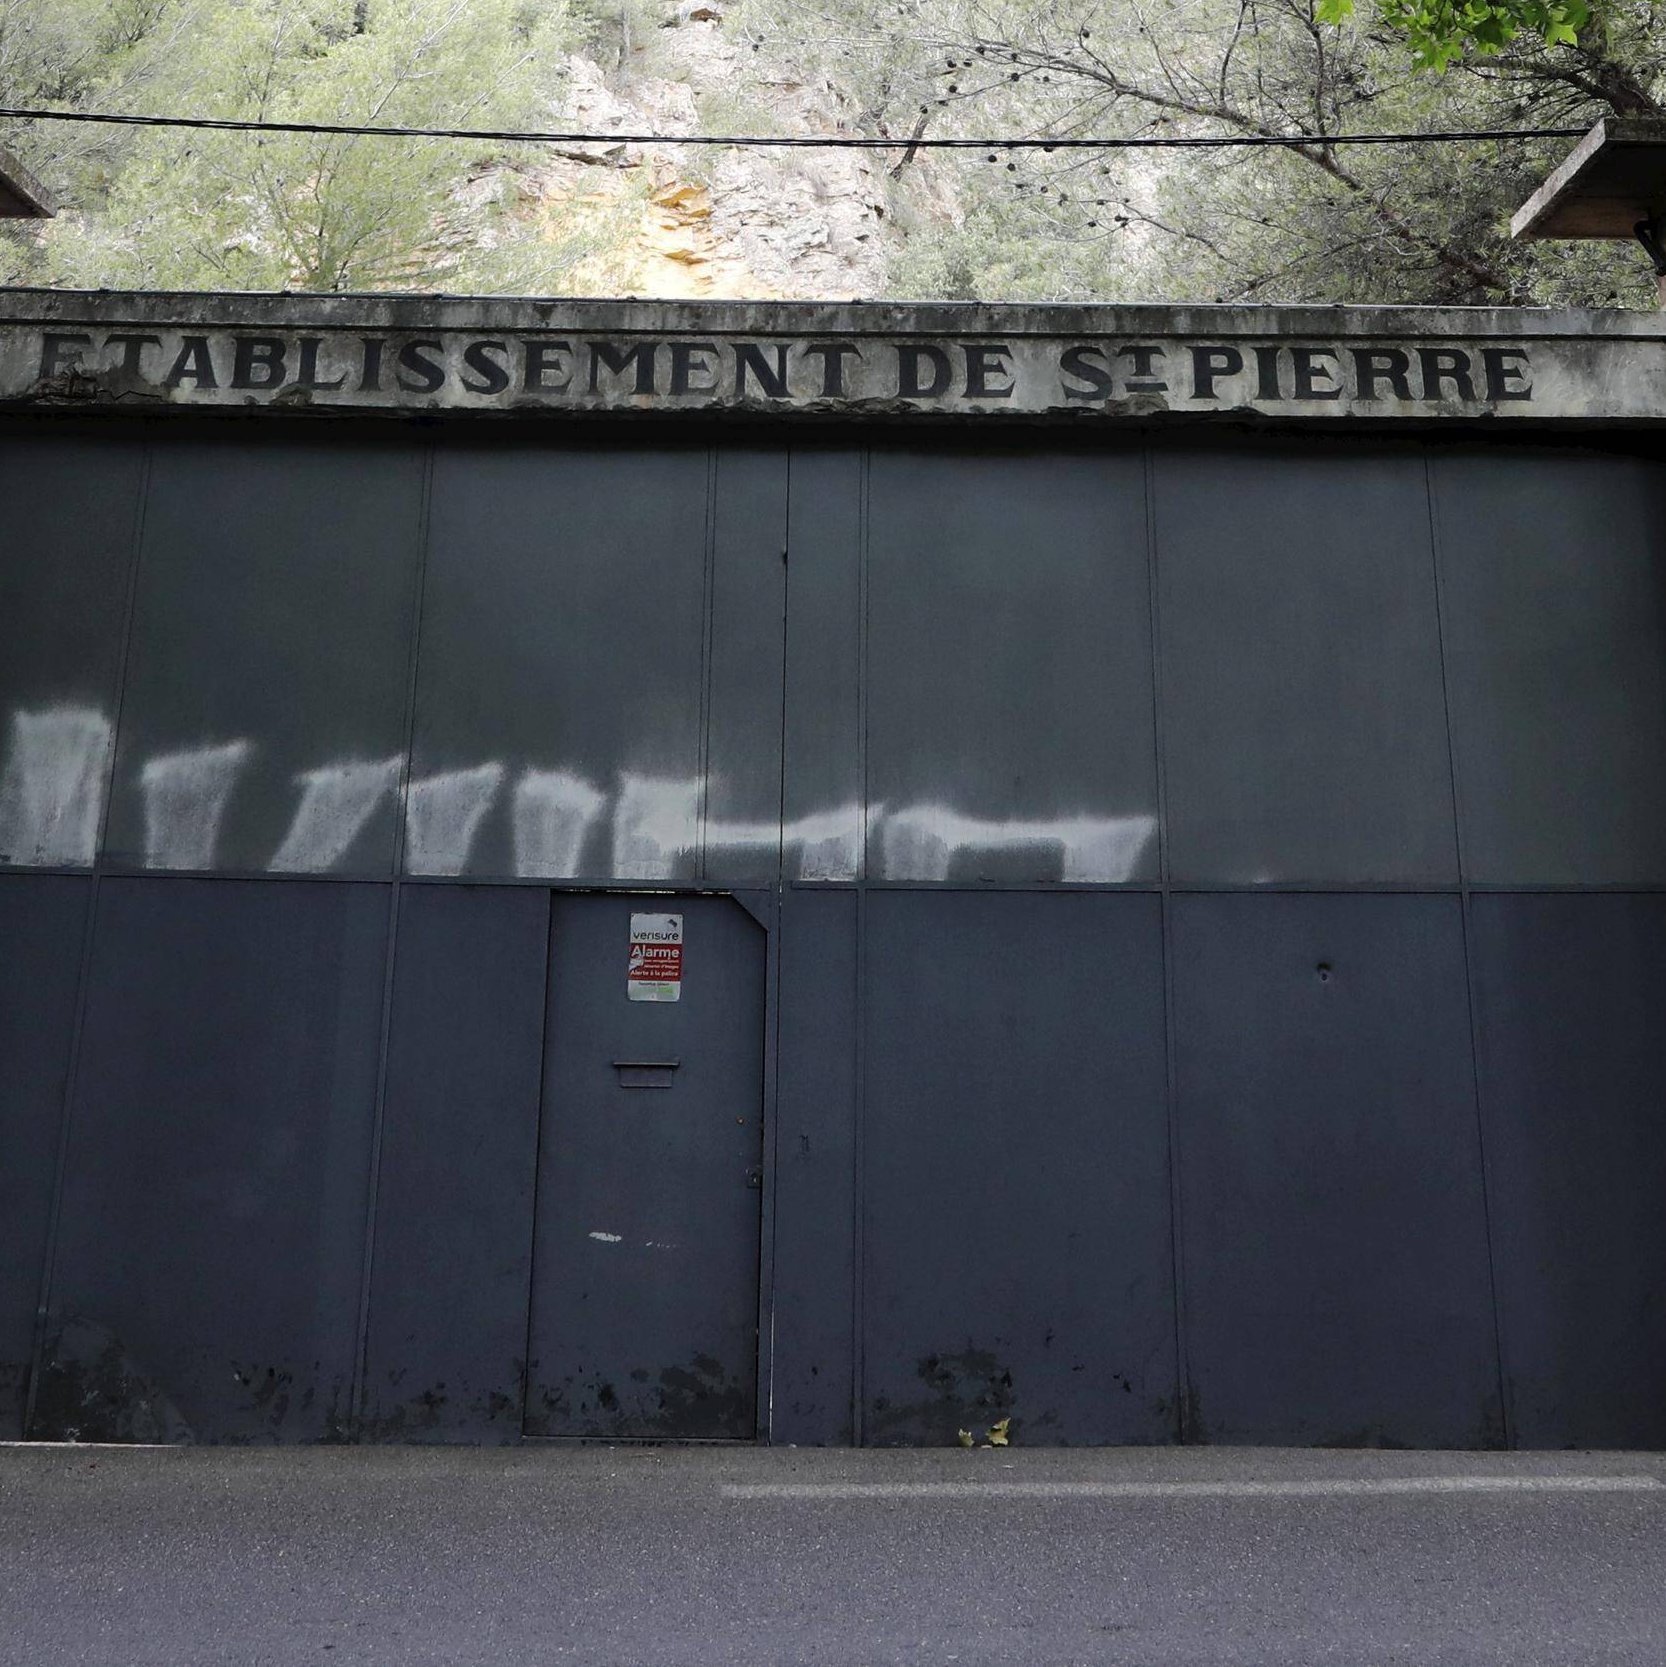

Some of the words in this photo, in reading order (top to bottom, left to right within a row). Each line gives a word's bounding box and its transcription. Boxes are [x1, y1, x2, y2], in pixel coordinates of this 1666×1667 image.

[895, 343, 1016, 399] DE
[1186, 345, 1534, 403] PIERRE
[633, 932, 679, 940] verisure
[631, 944, 680, 958] Alarme
